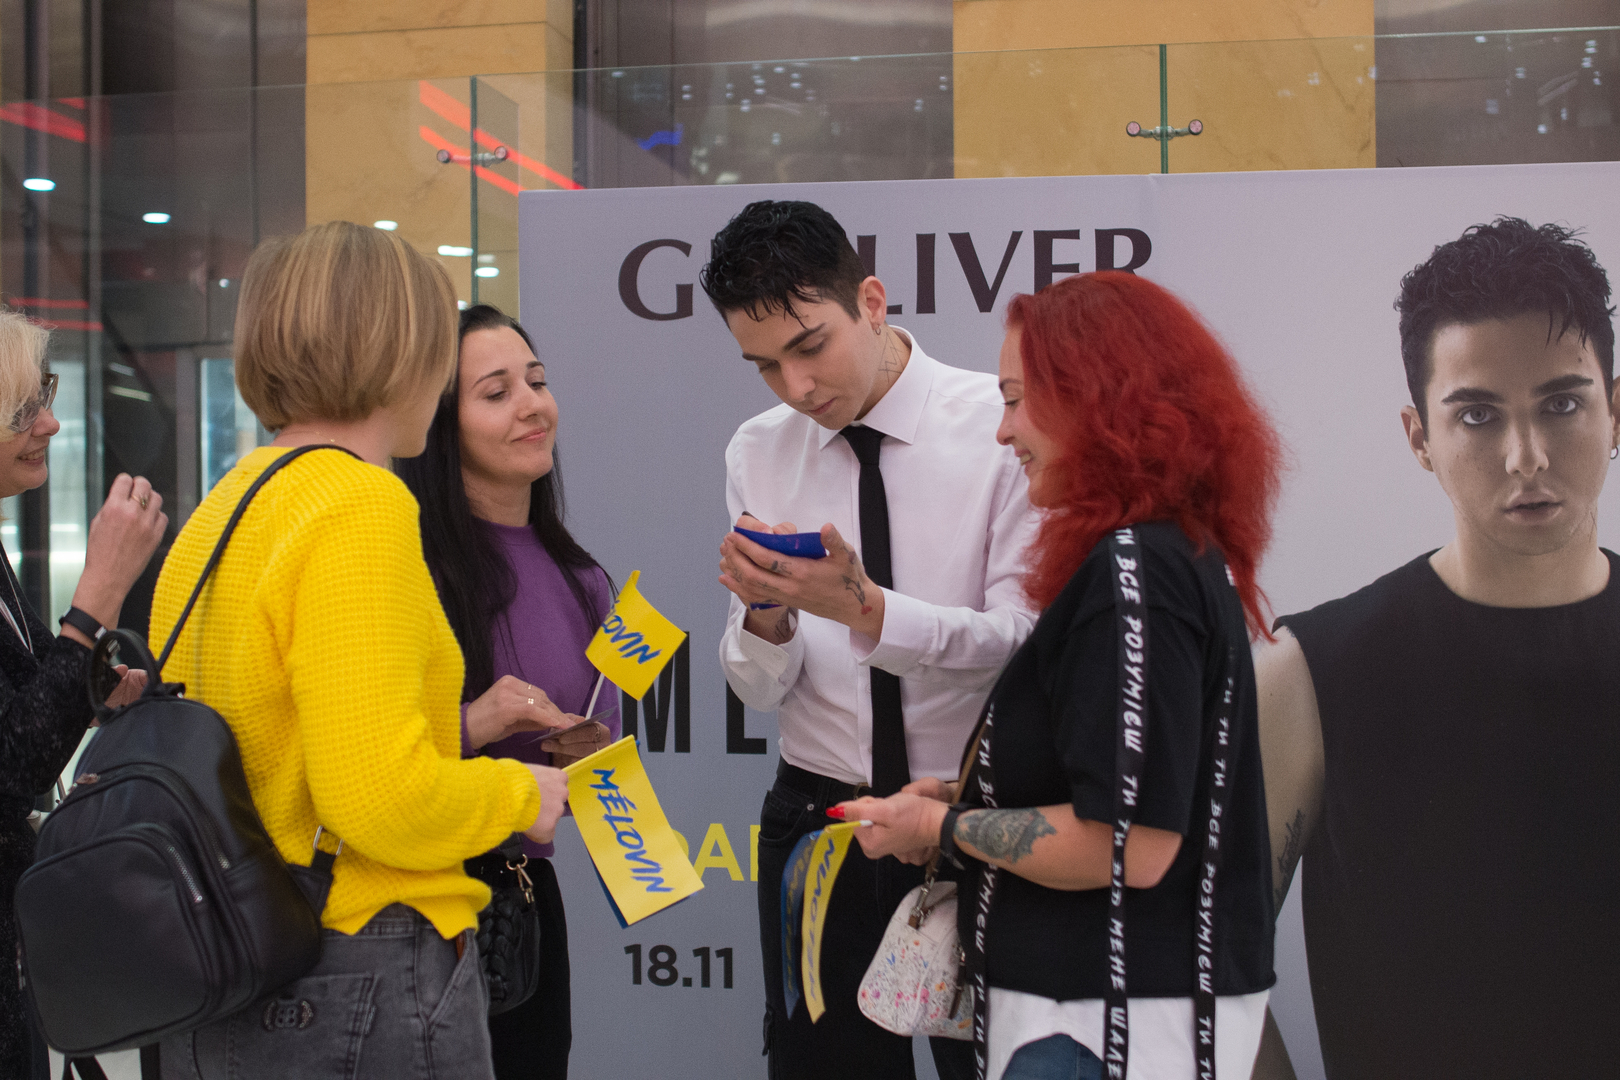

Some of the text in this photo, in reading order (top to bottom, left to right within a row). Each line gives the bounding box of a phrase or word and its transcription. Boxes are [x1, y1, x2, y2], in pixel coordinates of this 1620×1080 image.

[1115, 553, 1141, 605] ВСЕ
[1120, 613, 1145, 753] РОЗУМІЄШ
[1219, 717, 1229, 745] ТИ
[979, 738, 991, 767] ТИ
[1215, 758, 1227, 787] ТИ
[1122, 774, 1138, 806] ТИ
[1114, 819, 1131, 846] ТИ
[1208, 798, 1222, 850] ВСЕ
[1197, 862, 1217, 994] РОЗУМІЄШ
[623, 943, 733, 989] 18.11
[1109, 917, 1126, 992] МЕНЕ
[975, 1013, 985, 1043] ТИ
[1198, 1016, 1212, 1044] ТИ
